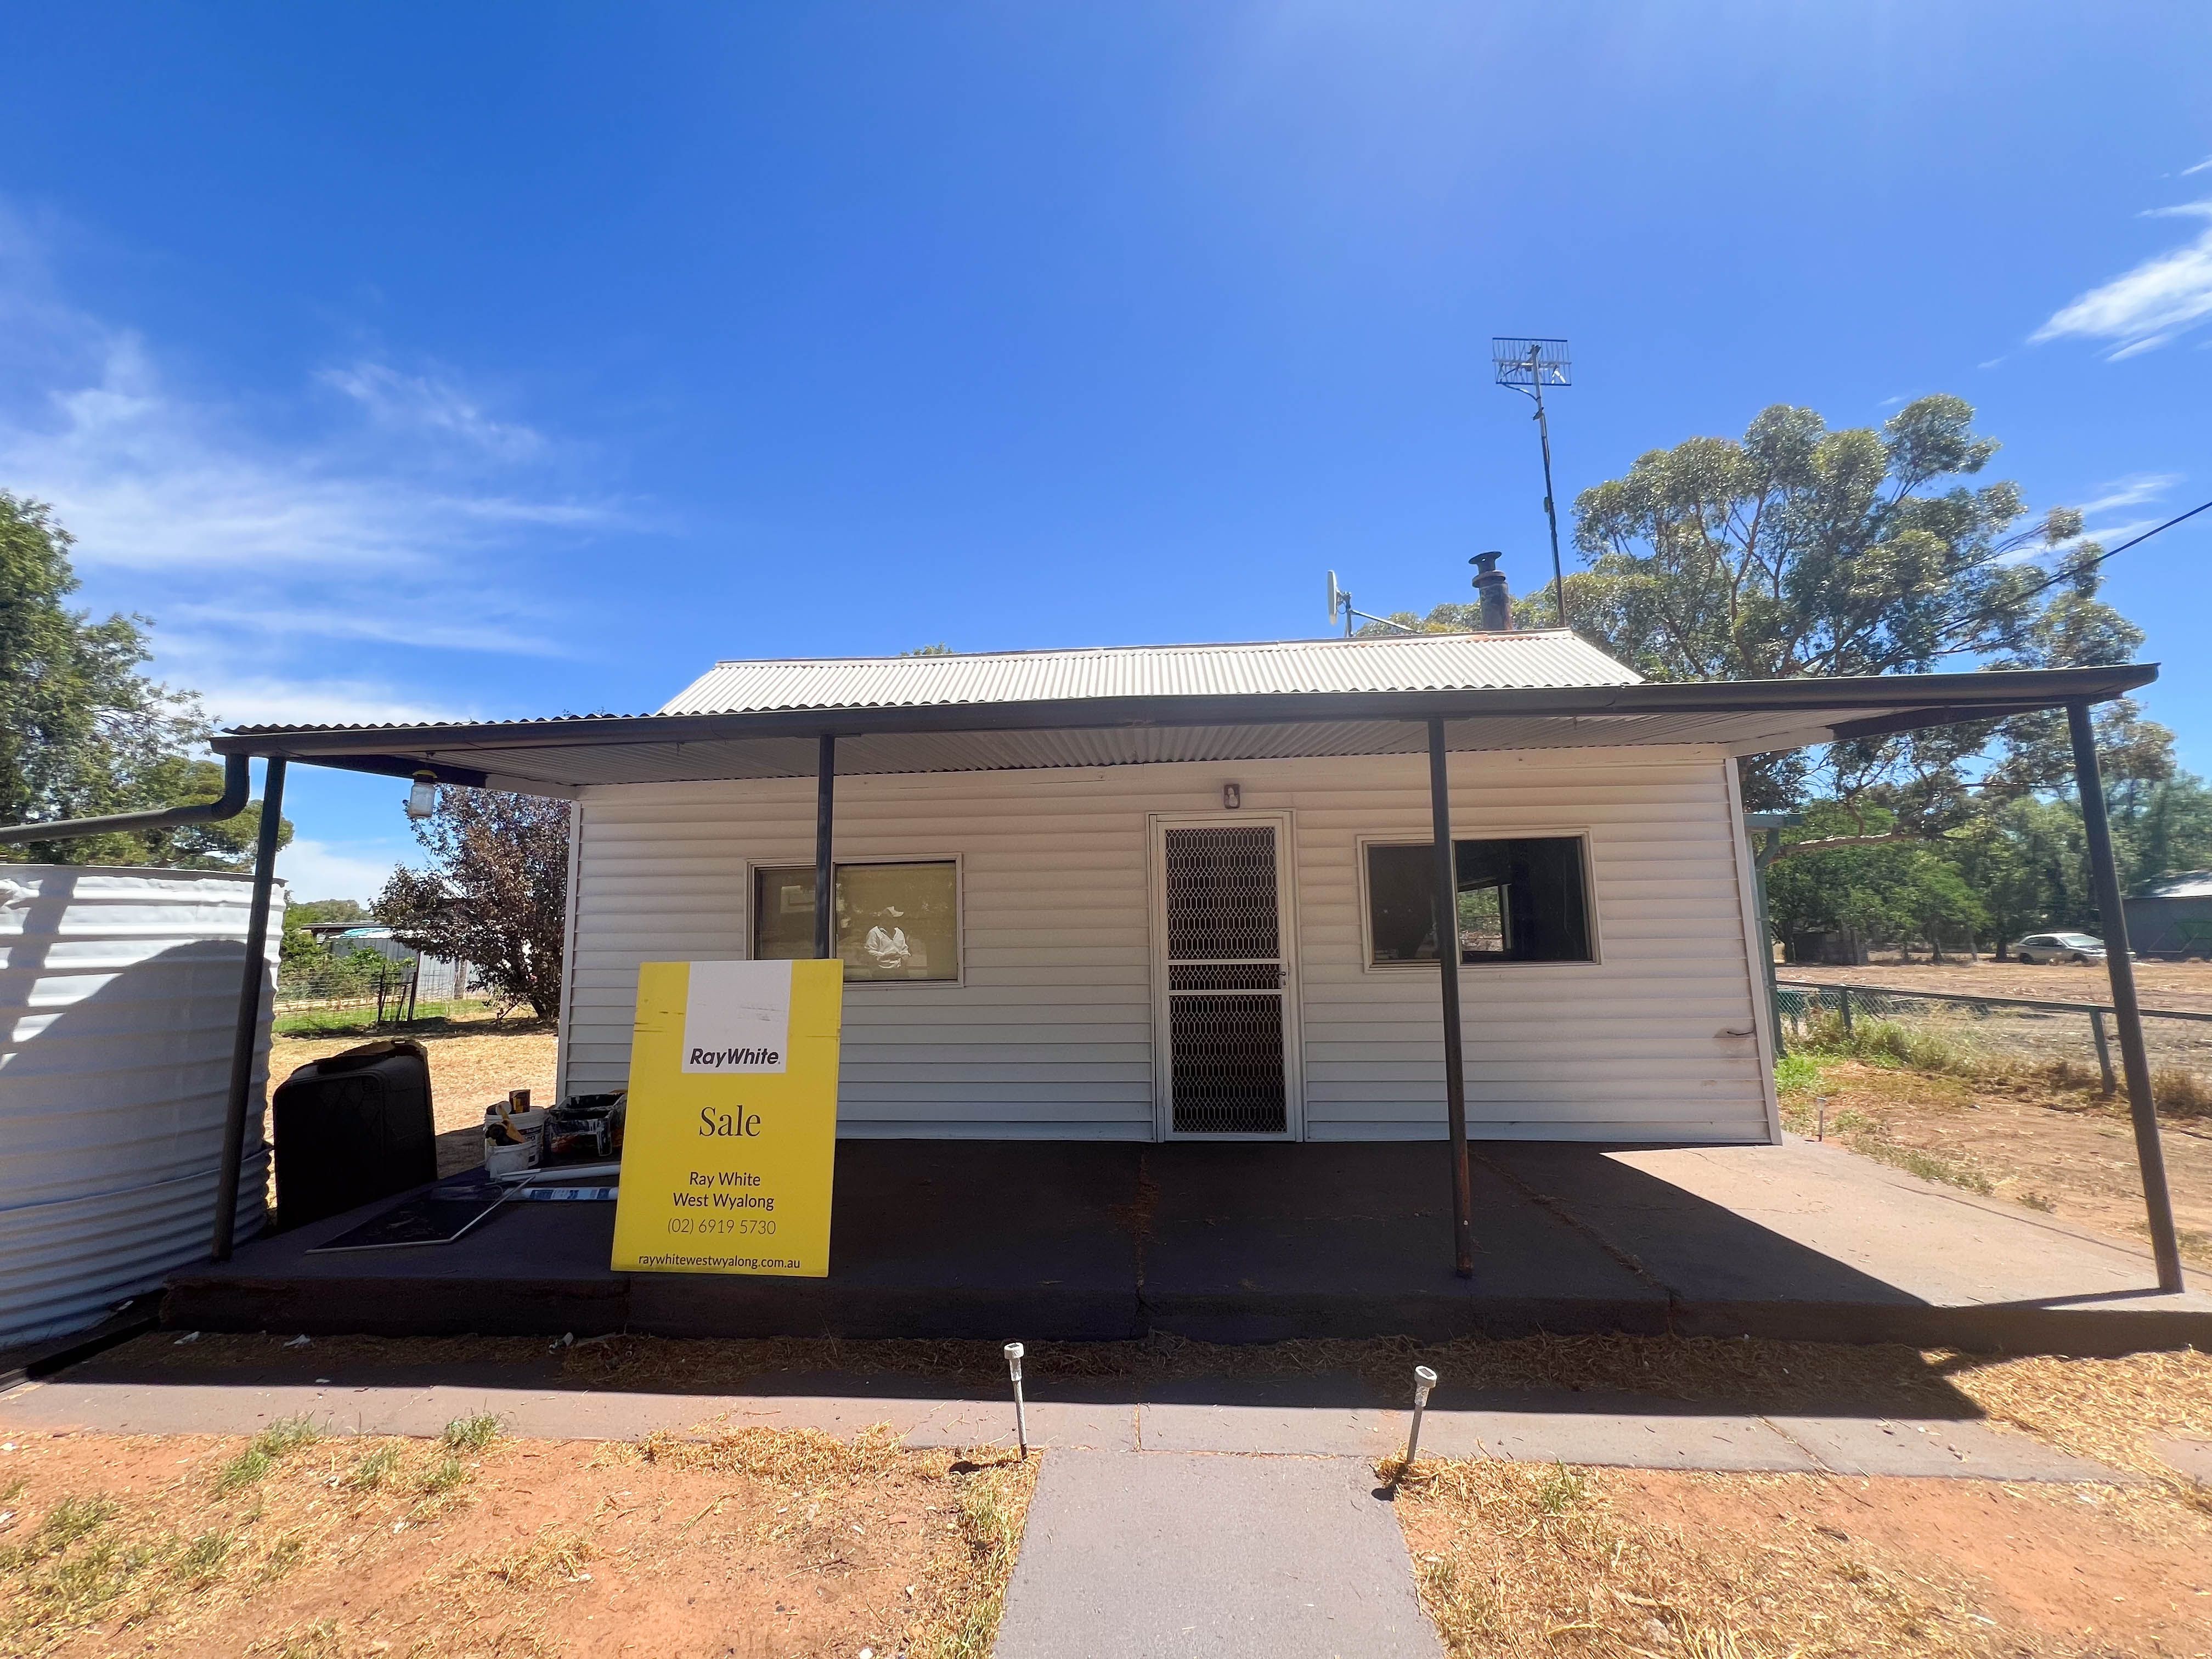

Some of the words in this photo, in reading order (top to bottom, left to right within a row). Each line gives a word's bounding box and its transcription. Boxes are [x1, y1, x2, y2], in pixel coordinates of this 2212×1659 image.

[699, 1105, 761, 1137] Sale
[690, 1172, 714, 1188] Ray
[719, 1172, 761, 1187] White
[673, 1193, 709, 1207] West
[713, 1193, 775, 1211] Wyalong
[668, 1218, 694, 1235] (02)
[698, 1218, 735, 1234] 6919
[740, 1220, 776, 1235] 5730
[639, 1254, 800, 1269] raywhitewestwyalong.com.au
